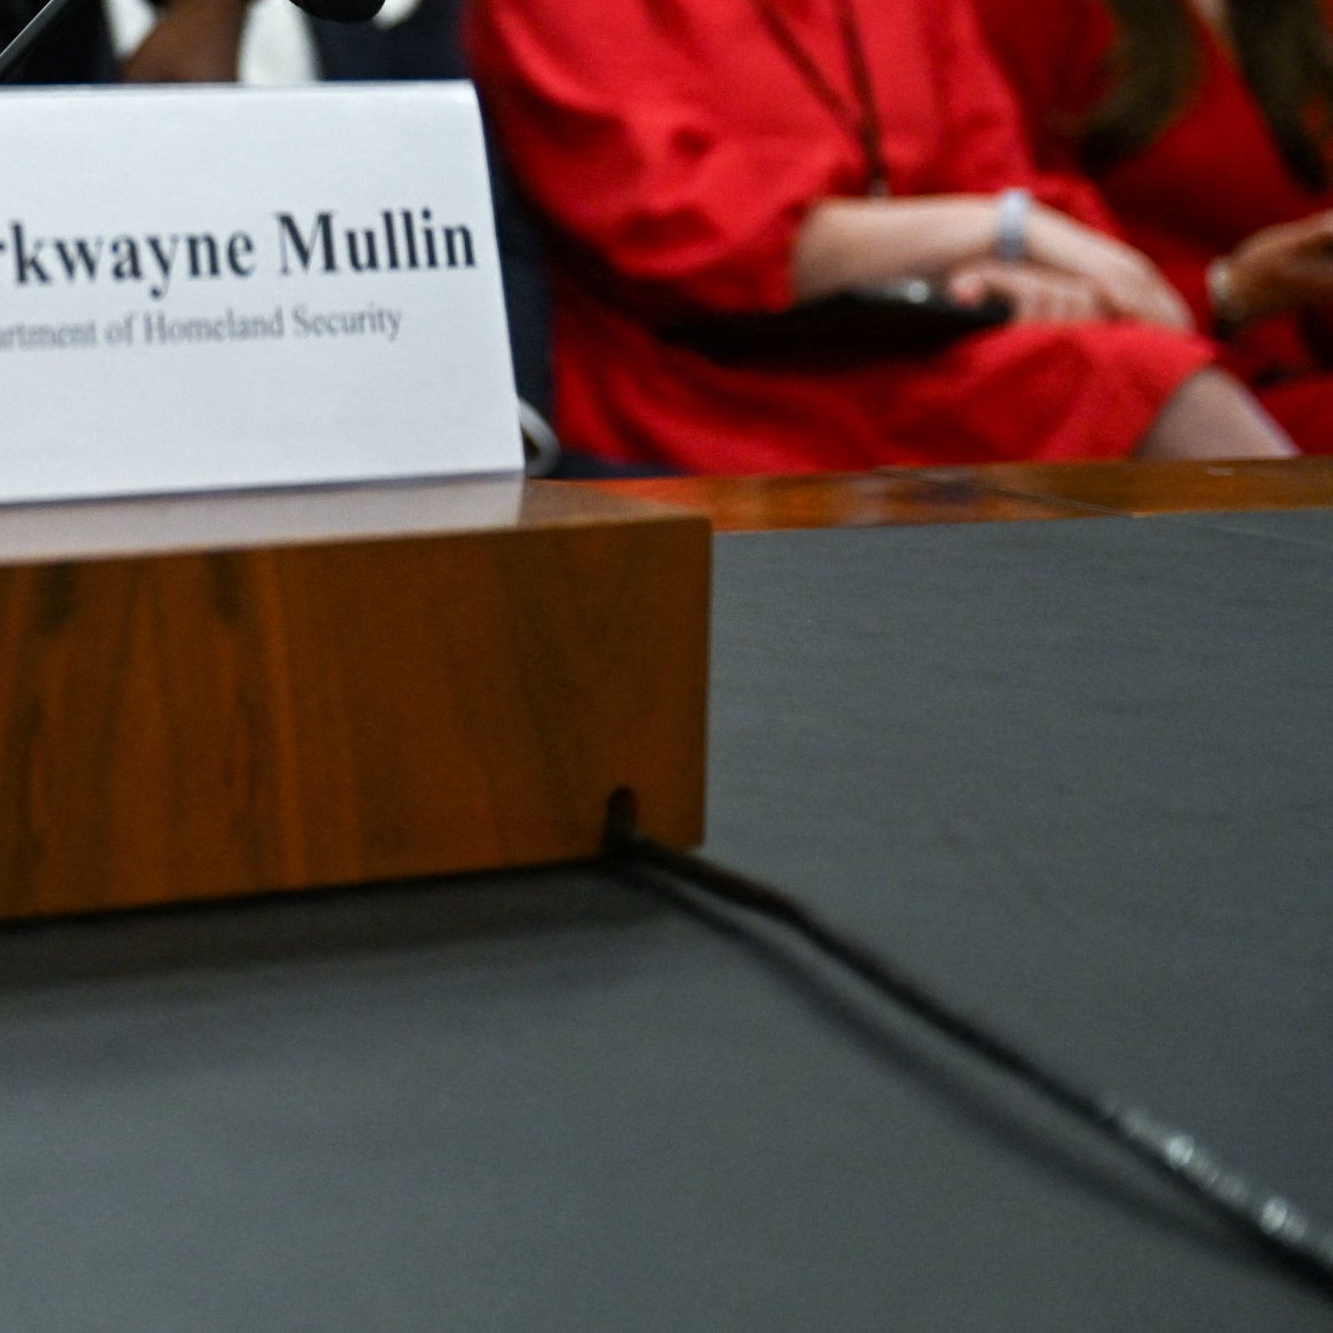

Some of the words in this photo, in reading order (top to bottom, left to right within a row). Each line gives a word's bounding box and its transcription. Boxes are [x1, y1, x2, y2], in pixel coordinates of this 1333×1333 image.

[276, 207, 476, 275] Mullin
[105, 313, 137, 348] of
[144, 308, 284, 346] Homeland
[293, 303, 402, 343] Security
